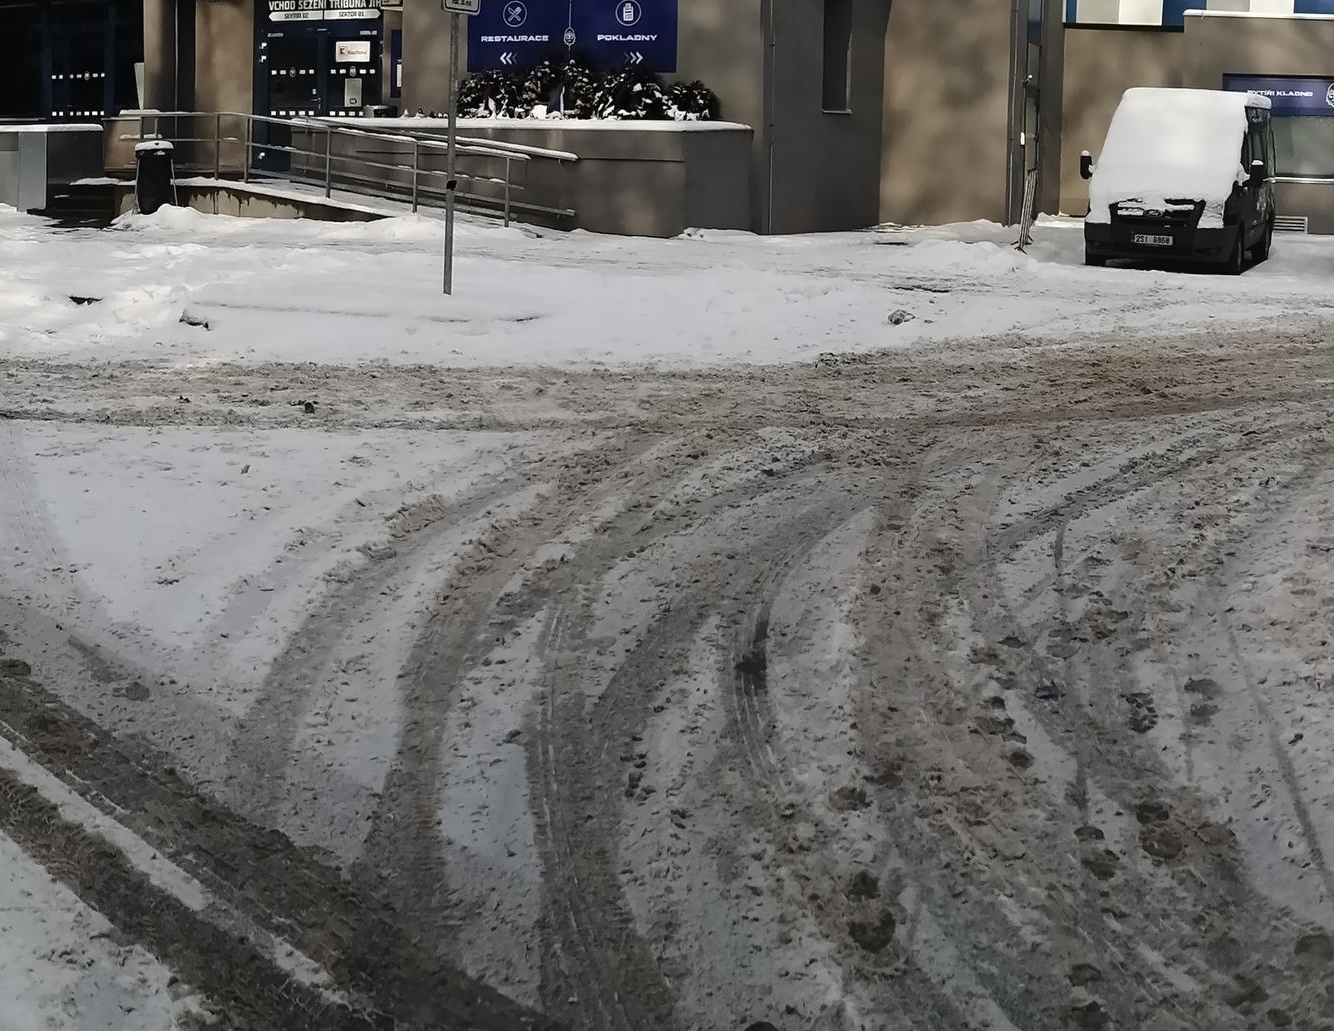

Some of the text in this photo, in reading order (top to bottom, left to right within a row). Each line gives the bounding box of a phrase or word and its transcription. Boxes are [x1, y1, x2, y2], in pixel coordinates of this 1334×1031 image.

[268, 0, 296, 11] VCHOD
[481, 35, 549, 43] RESTAURACE
[597, 34, 658, 42] POKLADNY
